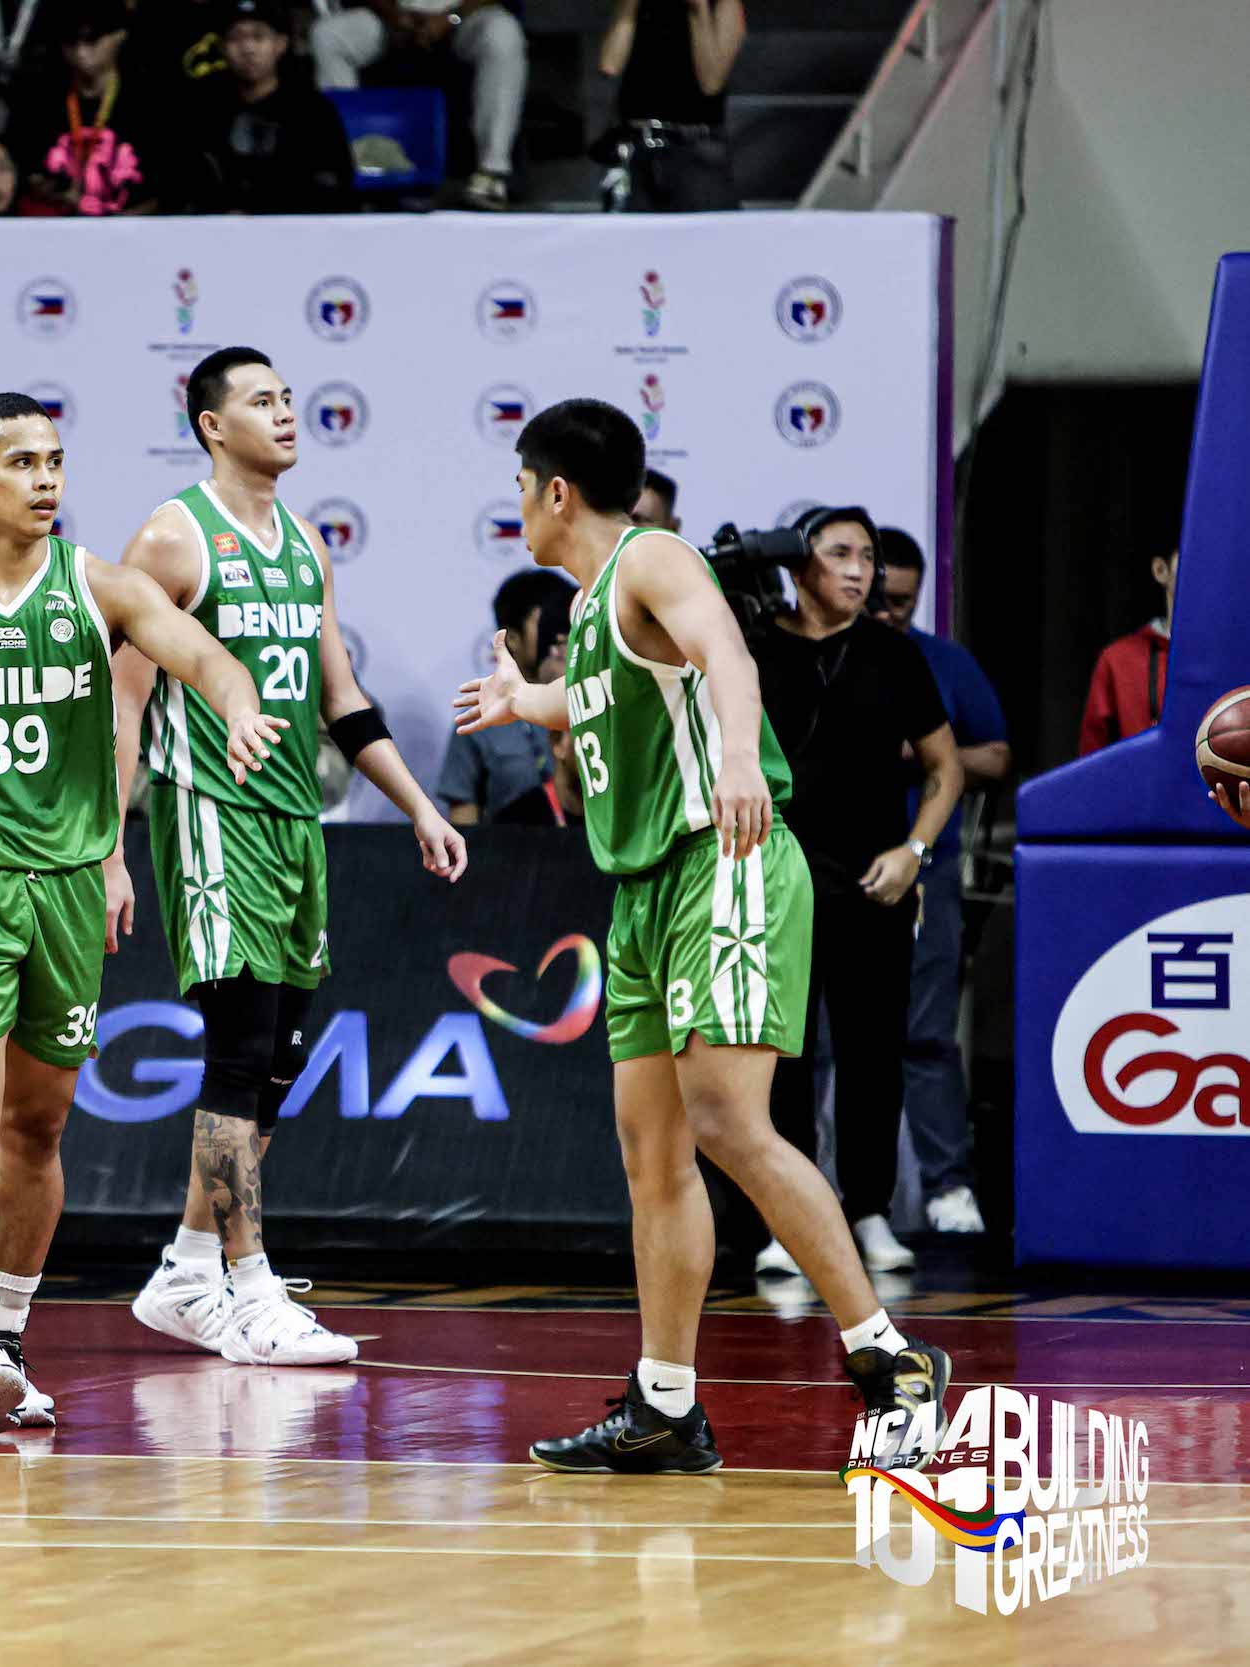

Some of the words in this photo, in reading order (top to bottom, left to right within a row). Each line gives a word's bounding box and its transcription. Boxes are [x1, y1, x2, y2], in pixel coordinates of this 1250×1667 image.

[46, 600, 65, 610] ANTA
[217, 602, 323, 639] BENILDE
[258, 645, 309, 701] 20
[574, 731, 609, 798] 13
[310, 929, 328, 967] 2
[1147, 933, 1233, 1010] 百
[56, 1002, 97, 1047] 39
